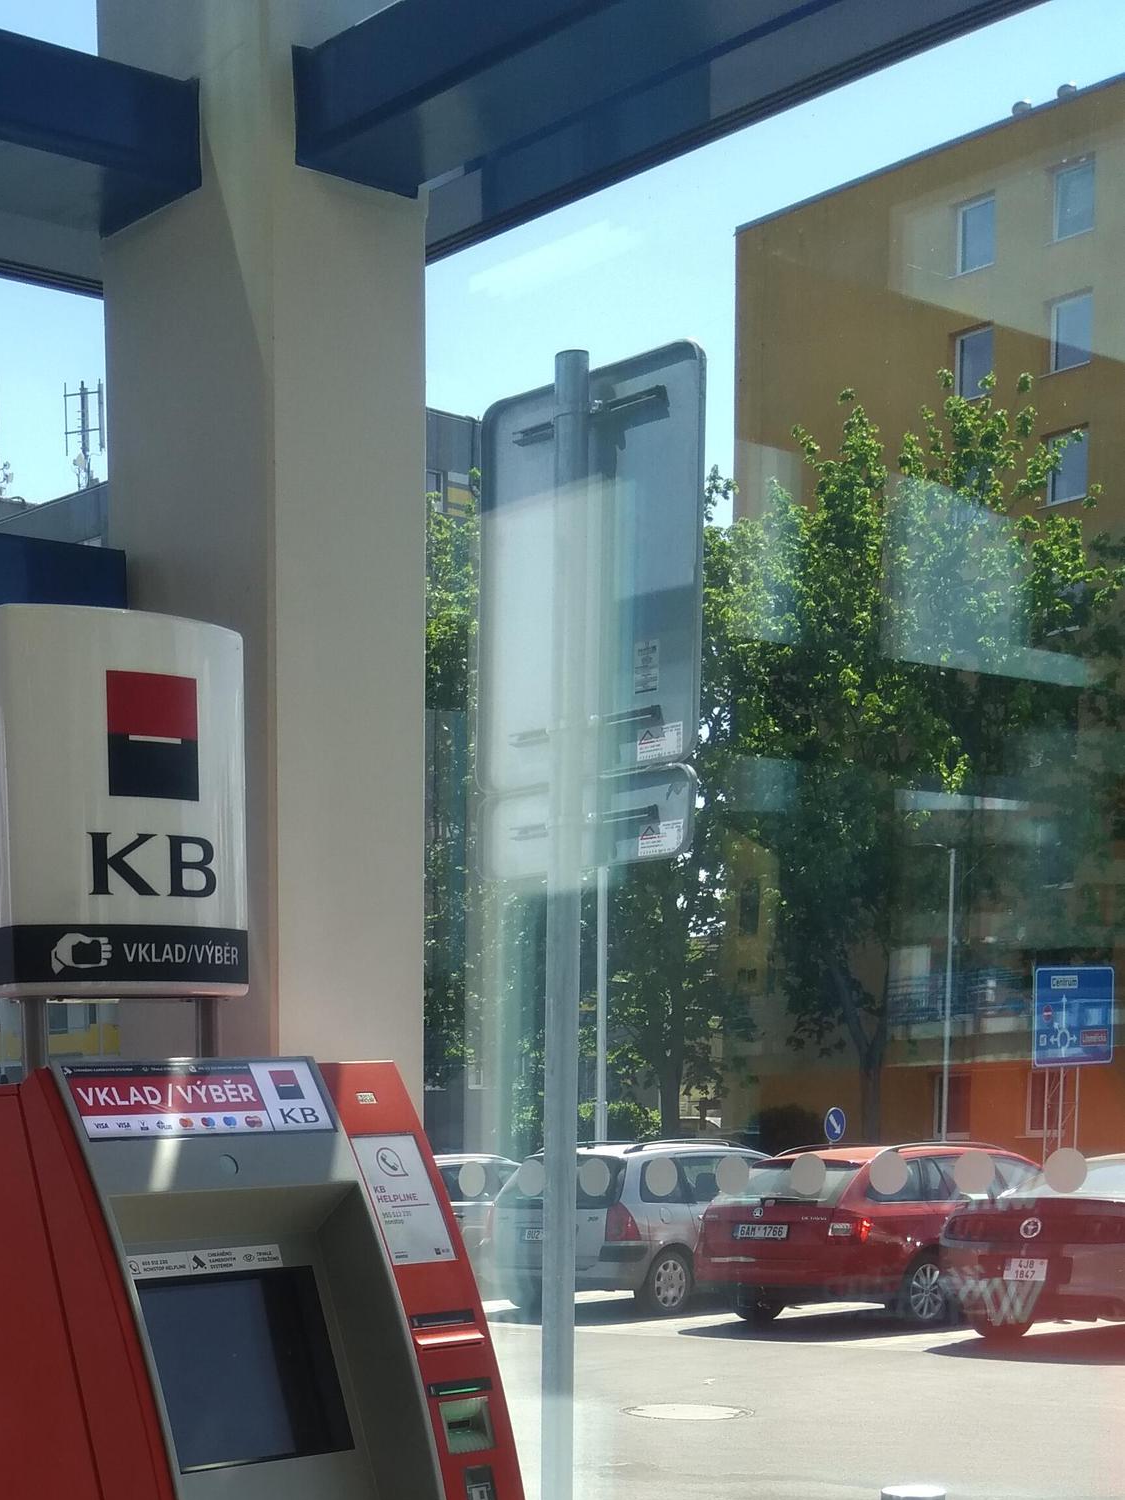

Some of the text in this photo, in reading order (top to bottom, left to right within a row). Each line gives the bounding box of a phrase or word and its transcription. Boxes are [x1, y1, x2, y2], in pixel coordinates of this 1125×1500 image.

[86, 831, 217, 898] KB
[123, 939, 239, 966] VKLAD/VÝBĚR
[279, 1107, 320, 1124] KB
[94, 1122, 110, 1130] VISA
[116, 1122, 131, 1130] VISA
[374, 1186, 386, 1194] KB
[377, 1193, 418, 1203] HELPLINE
[740, 1226, 783, 1237] 6AM 1766
[1018, 1260, 1035, 1268] 4J8
[1015, 1270, 1036, 1279] 1847
